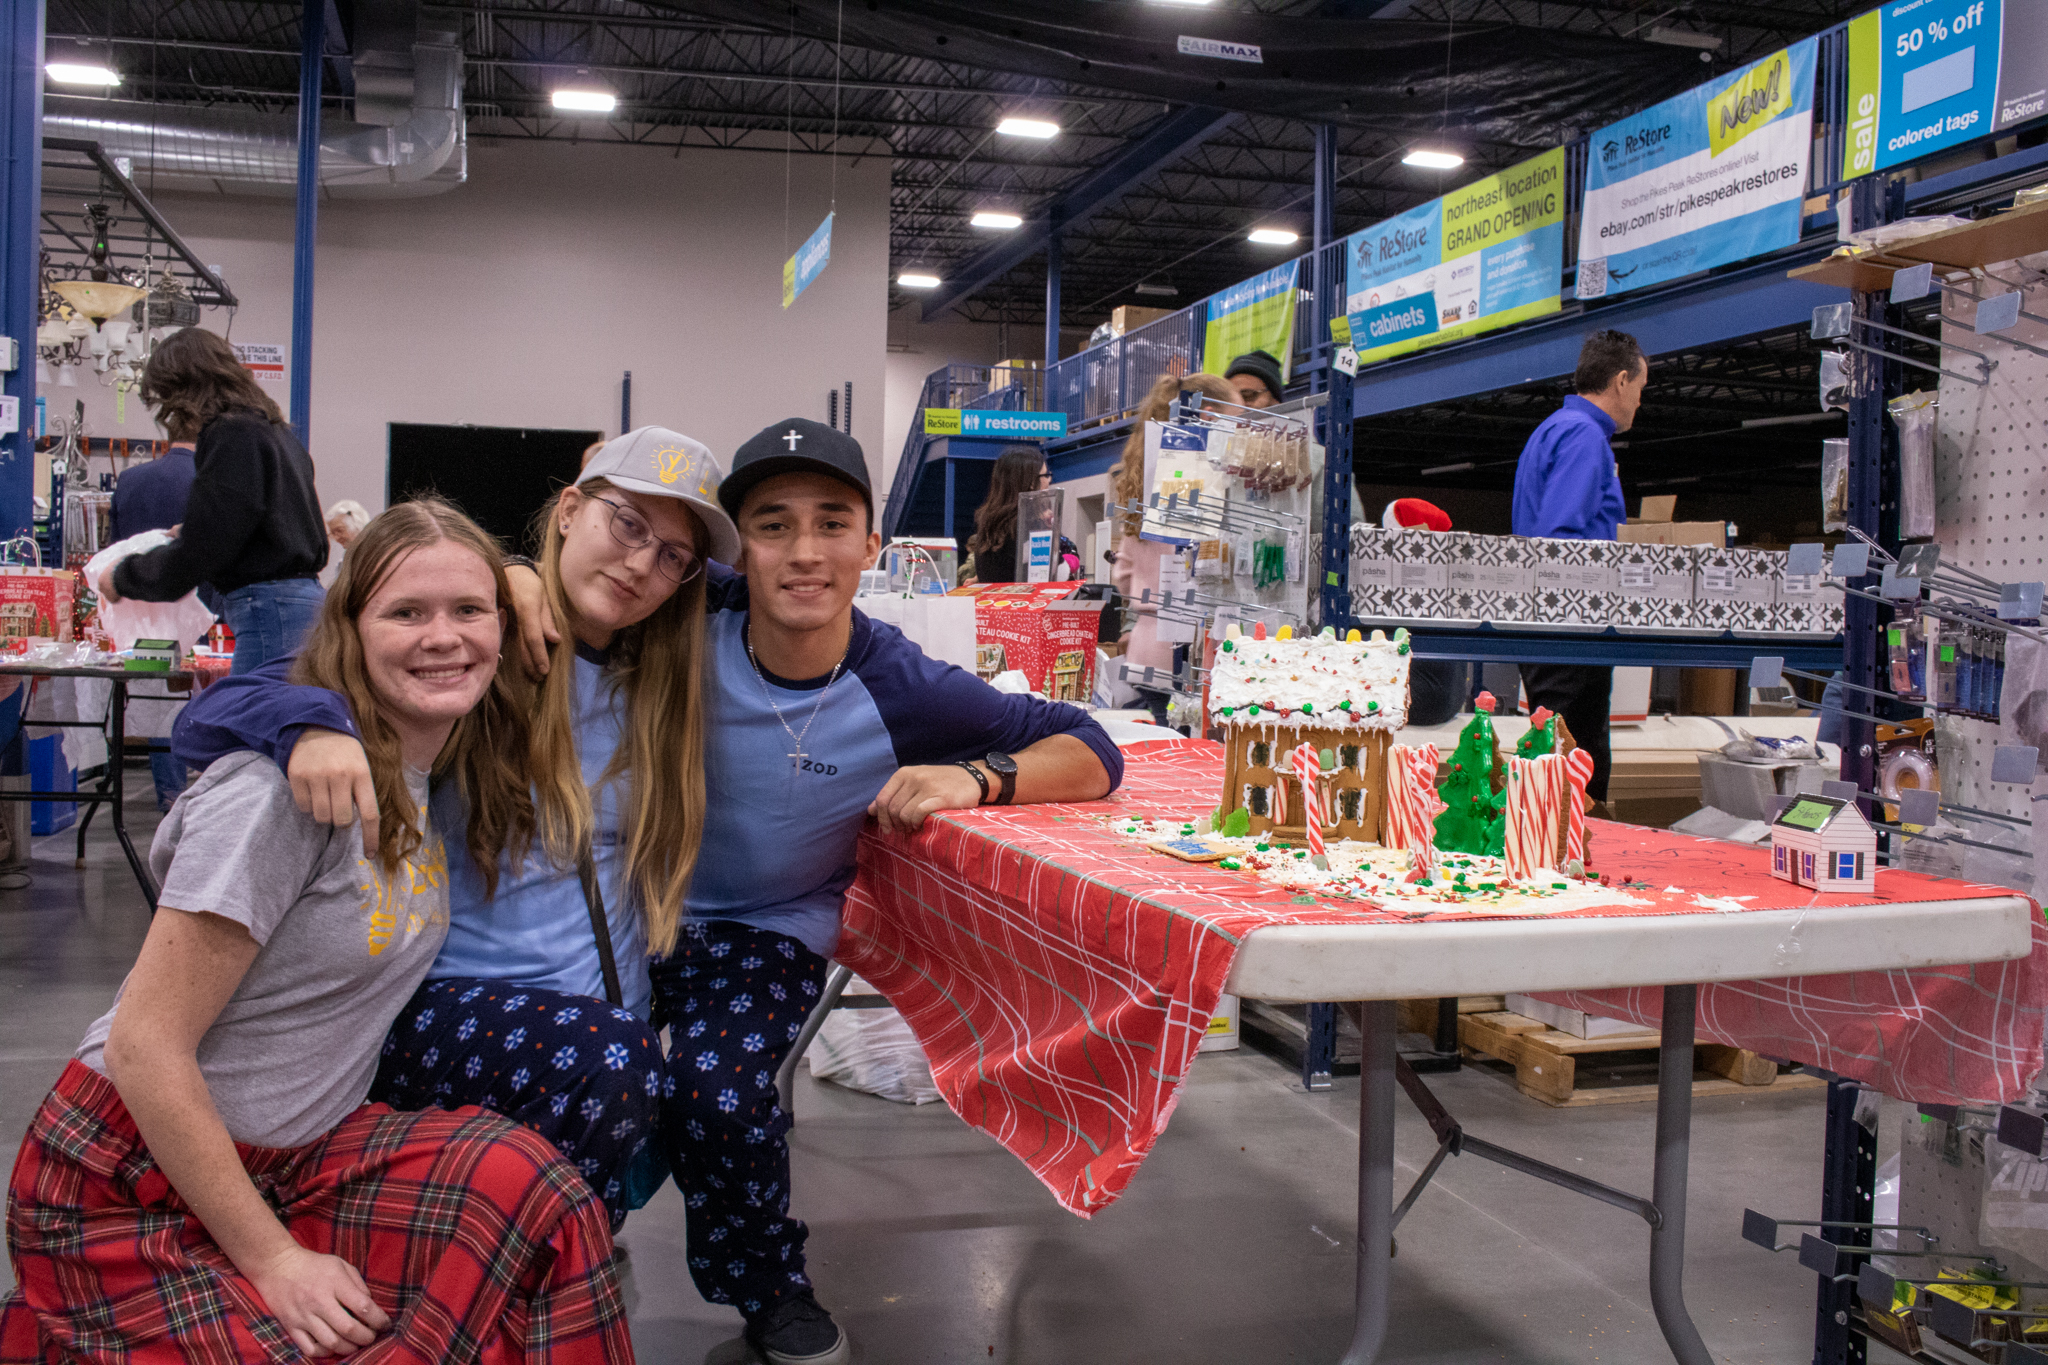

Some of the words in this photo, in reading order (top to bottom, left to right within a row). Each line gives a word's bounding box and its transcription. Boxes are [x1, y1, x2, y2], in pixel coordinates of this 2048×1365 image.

[1896, 28, 1923, 57] 50
[1928, 19, 1948, 43] %
[1953, 1, 1984, 35] off
[2001, 100, 2044, 123] ReStore
[1625, 124, 1671, 155] ReStore
[1852, 94, 1875, 170] sale
[1888, 118, 1943, 151] colored
[1946, 110, 1979, 131] tags
[1447, 185, 1503, 223] northeast
[1506, 165, 1557, 199] location
[1600, 162, 1798, 238] ebay.com/str/pikespeakrestores
[1447, 219, 1491, 251] GRAND
[1493, 193, 1556, 234] OPENING
[1379, 227, 1427, 262] ReStore
[1370, 306, 1426, 338] cabinets
[247, 346, 277, 354] STACKING
[253, 354, 267, 362] THIS
[1341, 356, 1353, 368] 14
[928, 419, 958, 429] ReStore
[985, 416, 1061, 431] restrooms
[996, 629, 1020, 641] COOKIE
[1020, 635, 1032, 644] KIT
[1046, 629, 1075, 640] GINGERBREAD
[1075, 630, 1093, 639] CHATEAU
[1991, 1150, 2048, 1199] Zip
